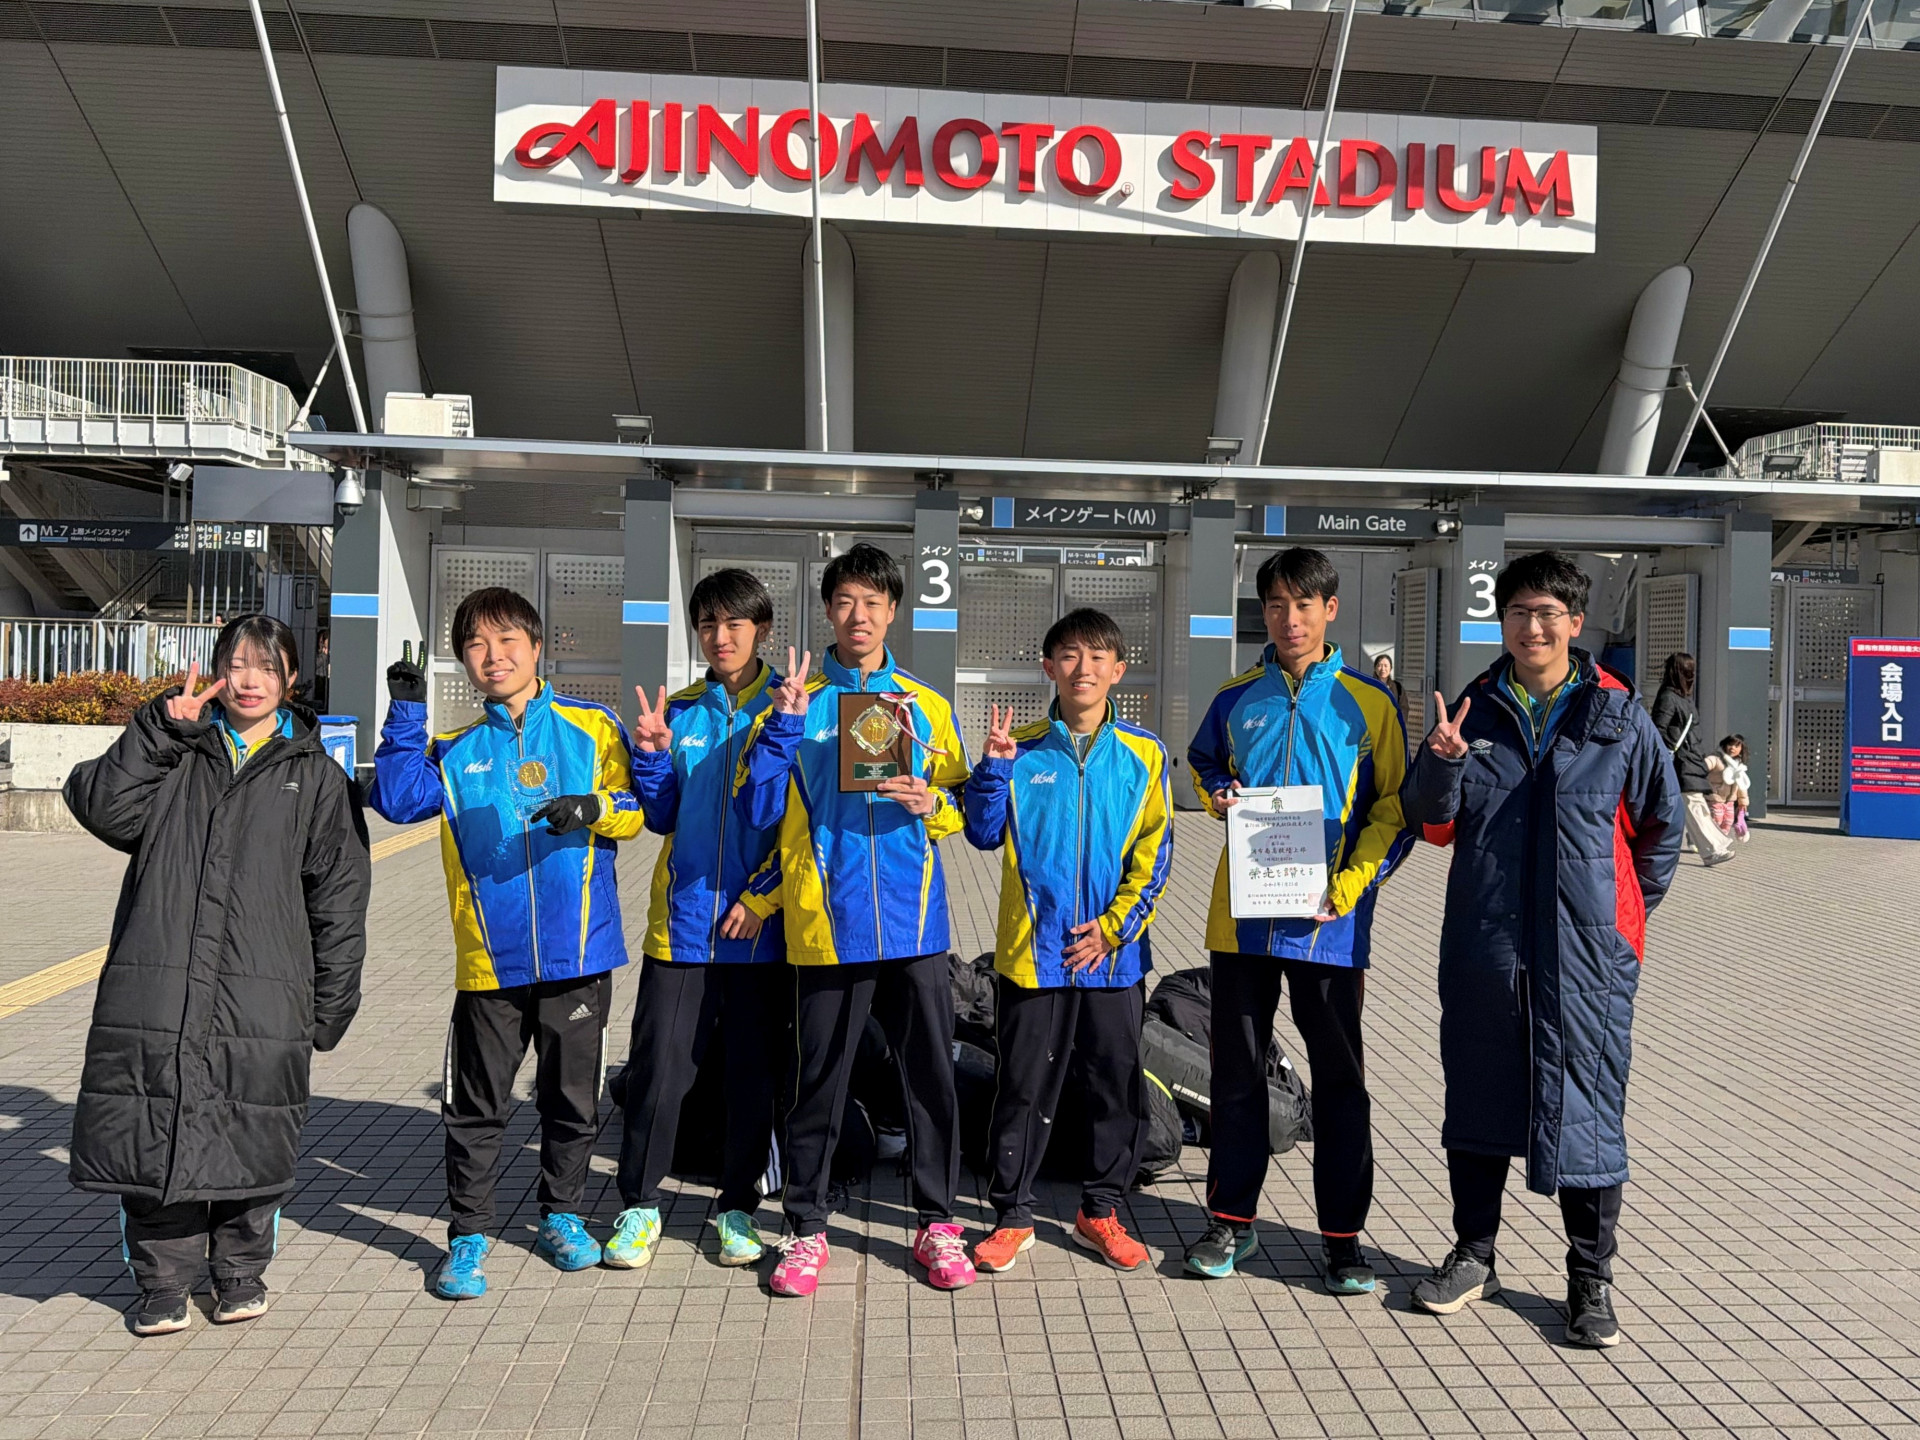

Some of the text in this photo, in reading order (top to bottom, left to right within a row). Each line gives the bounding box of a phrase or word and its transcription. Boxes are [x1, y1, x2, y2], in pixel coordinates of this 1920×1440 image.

[513, 97, 1575, 217] AJINOMOTO STADIUM
[1025, 506, 1157, 526] メインゲート(M)
[1318, 514, 1407, 532] Main Gate
[40, 525, 69, 537] M-7
[174, 541, 189, 549] B-28
[920, 545, 952, 556] メイン
[1108, 557, 1125, 566] 入口
[1467, 560, 1498, 571] メイン
[919, 559, 952, 604] 3
[1466, 573, 1498, 618] 3
[1880, 662, 1903, 742] 会場入口
[568, 1011, 593, 1021] adidas
